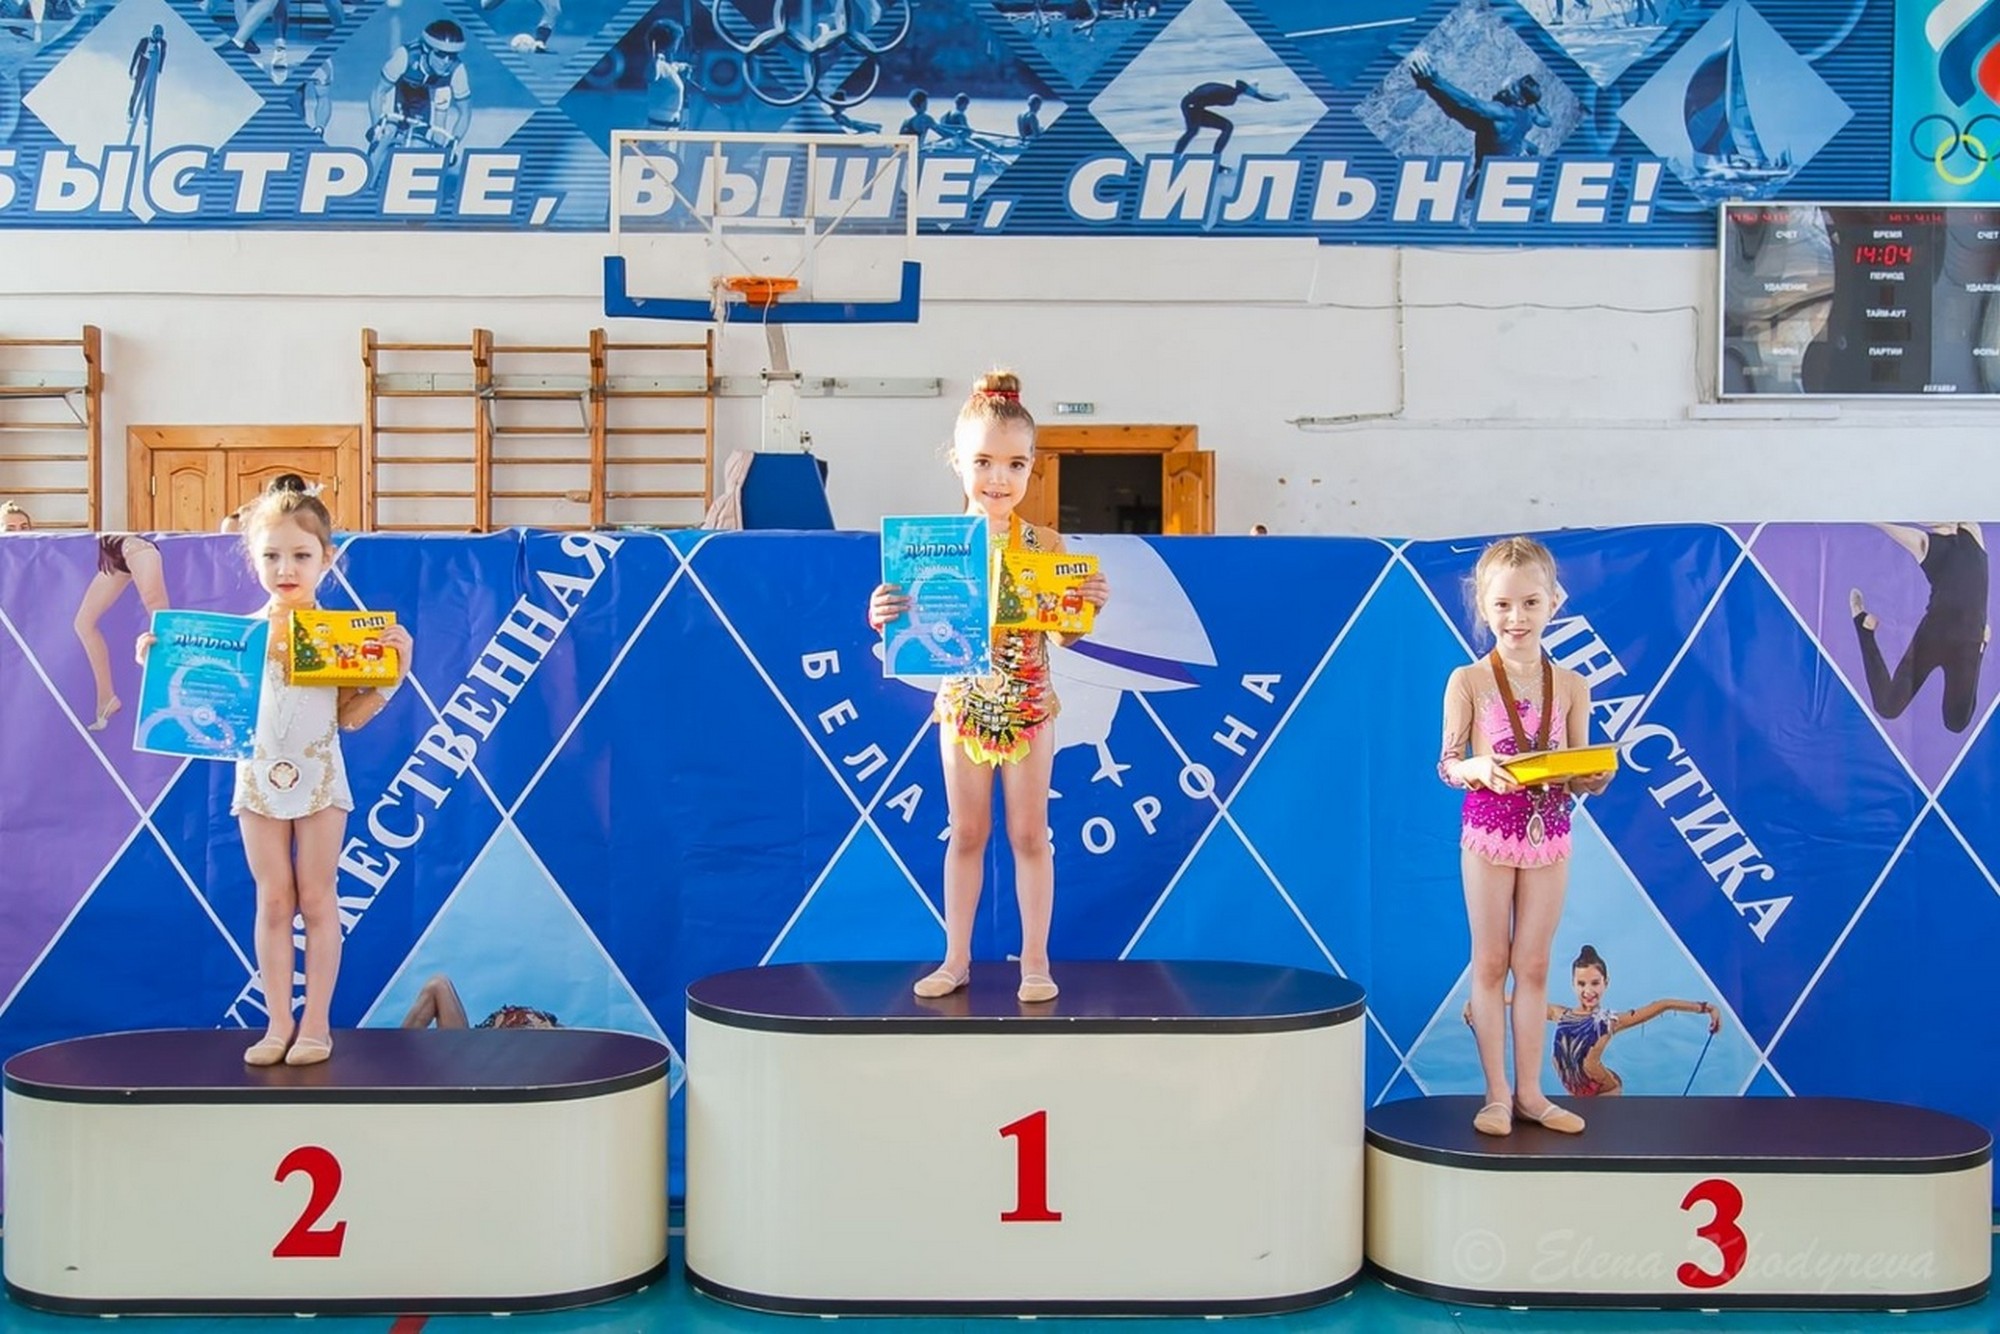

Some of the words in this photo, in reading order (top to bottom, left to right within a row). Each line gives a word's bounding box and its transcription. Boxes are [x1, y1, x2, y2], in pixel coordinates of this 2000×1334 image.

[619, 155, 1012, 228] ВЫШЕ,
[1068, 158, 1663, 224] СИЛЬНЕЕ!
[1873, 230, 1903, 239] ВРЕМЯ
[1855, 245, 1913, 266] 14:04
[1869, 271, 1905, 281] ПЕРИОД
[1865, 308, 1907, 318] ТАЙМ-АУТ
[216, 532, 626, 1029] ЕСТВЕННАЯ
[800, 649, 951, 842] БЕЛА
[1048, 671, 1282, 857] ОРОНА
[1541, 581, 1793, 943] МНАСТИКА
[272, 1144, 347, 1258] 2
[999, 1110, 1062, 1222] 1
[1676, 1178, 1748, 1289] 3
